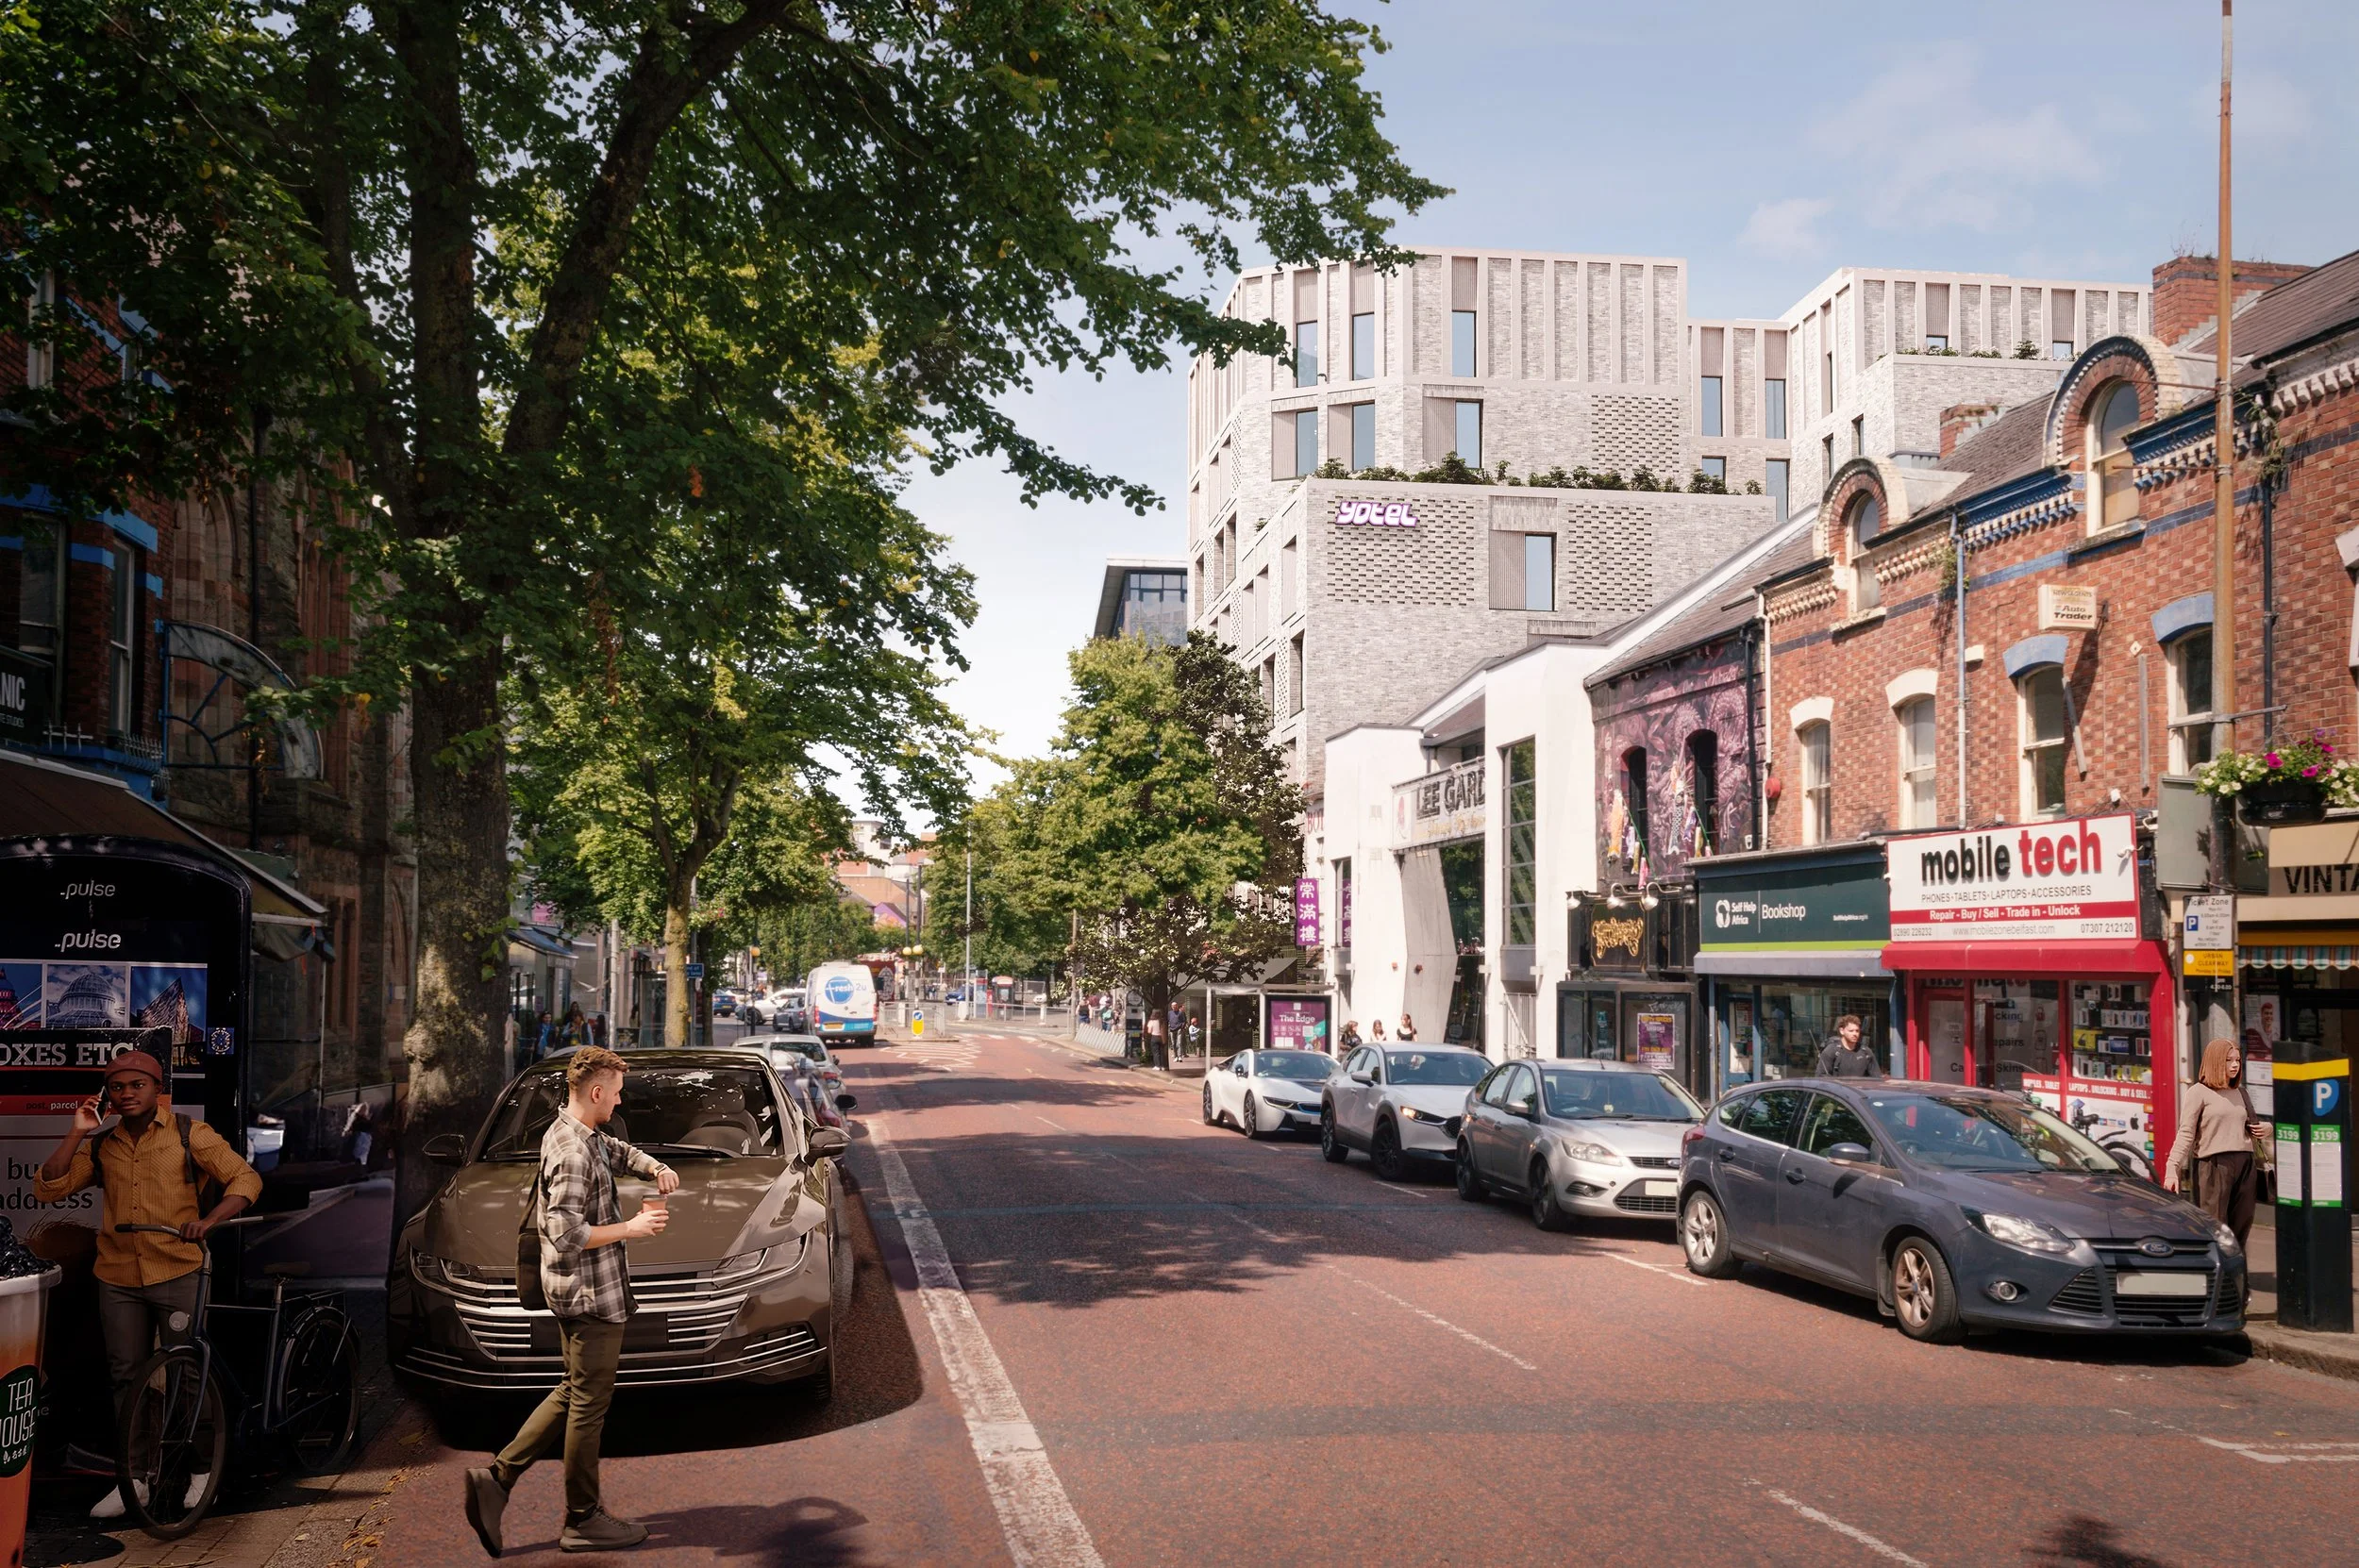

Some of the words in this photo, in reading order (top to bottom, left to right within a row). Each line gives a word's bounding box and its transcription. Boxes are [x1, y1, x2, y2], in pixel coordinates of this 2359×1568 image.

[0, 671, 26, 711] NIC
[1416, 781, 1441, 820] LEE
[1921, 835, 2012, 884] mobile
[2018, 817, 2102, 877] tech
[1731, 902, 1743, 913] Self
[1743, 901, 1756, 914] Help
[2211, 897, 2229, 906] Zone
[1732, 914, 1748, 926] Africa
[1762, 903, 1806, 921] Bookshop
[1930, 909, 1954, 922] Repair
[1961, 909, 1977, 921] Buy
[1983, 908, 1999, 919] Sell
[2006, 906, 2031, 918] Trade
[2032, 907, 2040, 917] in
[2048, 905, 2081, 916] Unlock
[2081, 923, 2103, 934] 07307
[2105, 922, 2133, 933] 212120
[1279, 1014, 1294, 1023] The
[1296, 1013, 1315, 1024] Edge
[2316, 1082, 2332, 1109] P
[2277, 1129, 2300, 1140] 3199
[2313, 1130, 2338, 1141] 3199
[8, 1377, 34, 1412] TEA
[0, 1406, 37, 1448] OUSE
